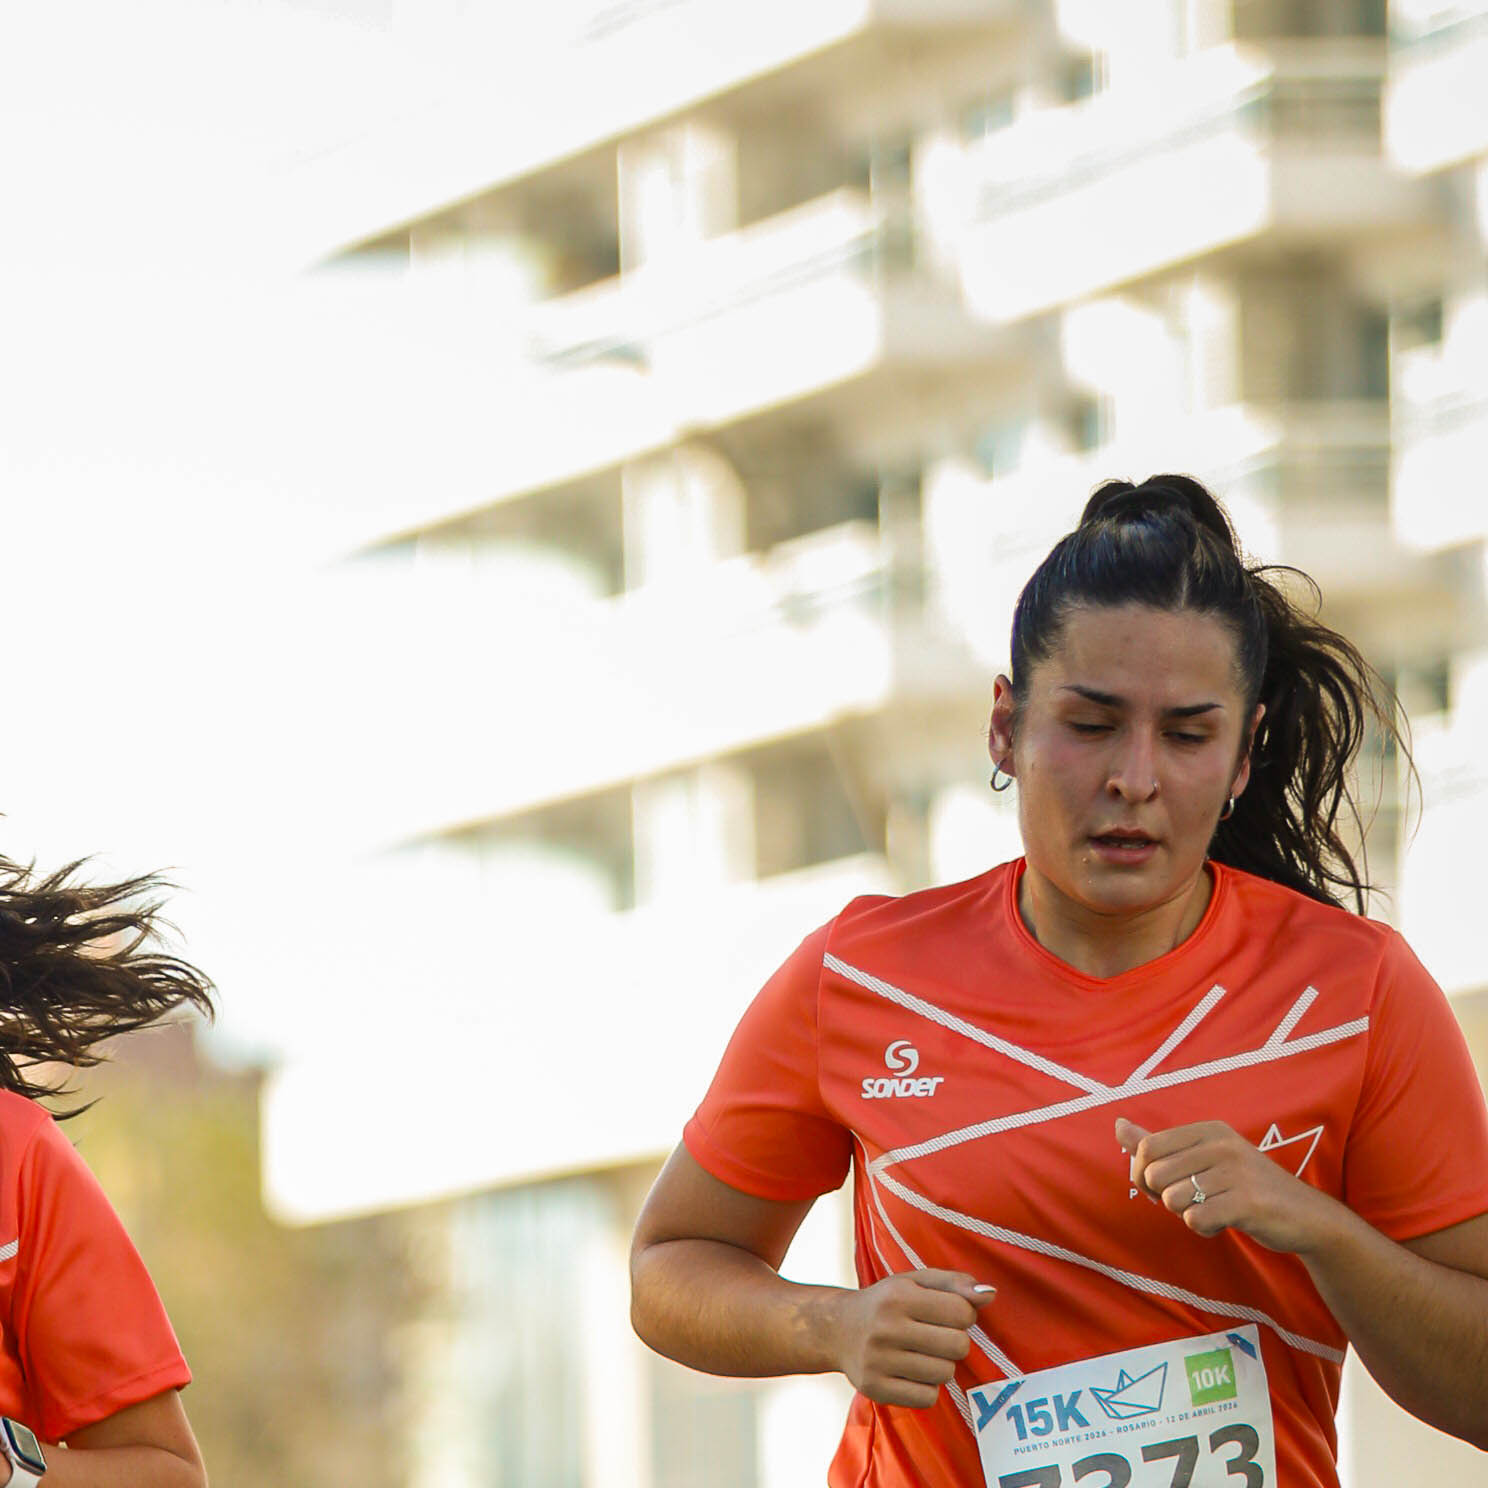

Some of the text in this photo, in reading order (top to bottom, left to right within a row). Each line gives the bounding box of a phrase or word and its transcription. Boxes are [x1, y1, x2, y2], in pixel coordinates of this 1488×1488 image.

[1191, 1362, 1232, 1391] 10K
[1005, 1389, 1091, 1441] 15K
[1013, 1441, 1049, 1455] PUERTO
[1052, 1434, 1081, 1447] NORTE
[1116, 1419, 1156, 1434] ROSARIO
[1178, 1412, 1190, 1421] DE
[1192, 1406, 1215, 1417] ABRIL
